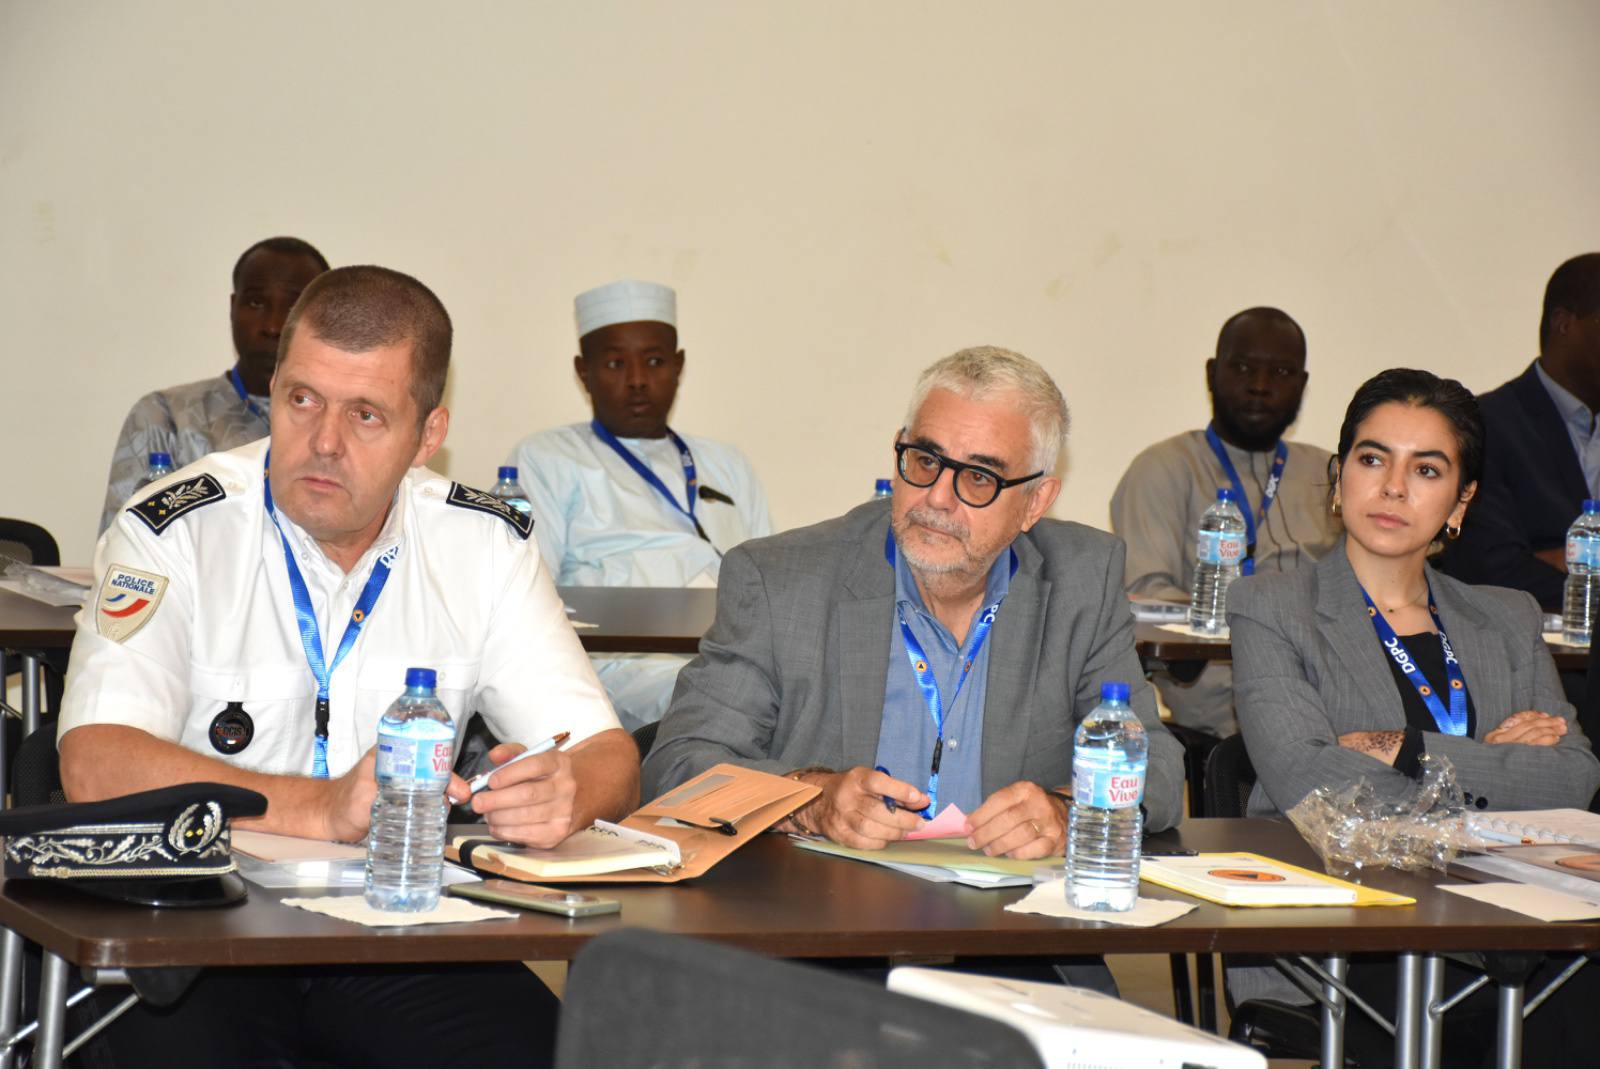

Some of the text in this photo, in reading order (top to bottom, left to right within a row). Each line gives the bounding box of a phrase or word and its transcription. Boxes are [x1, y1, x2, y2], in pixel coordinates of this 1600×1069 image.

[111, 579, 155, 595] NATIONALE
[117, 574, 155, 588] POLICE
[984, 604, 1000, 623] PC
[1384, 637, 1416, 674] DGPC
[1111, 776, 1138, 789] Eau
[1108, 789, 1139, 802] Vive
